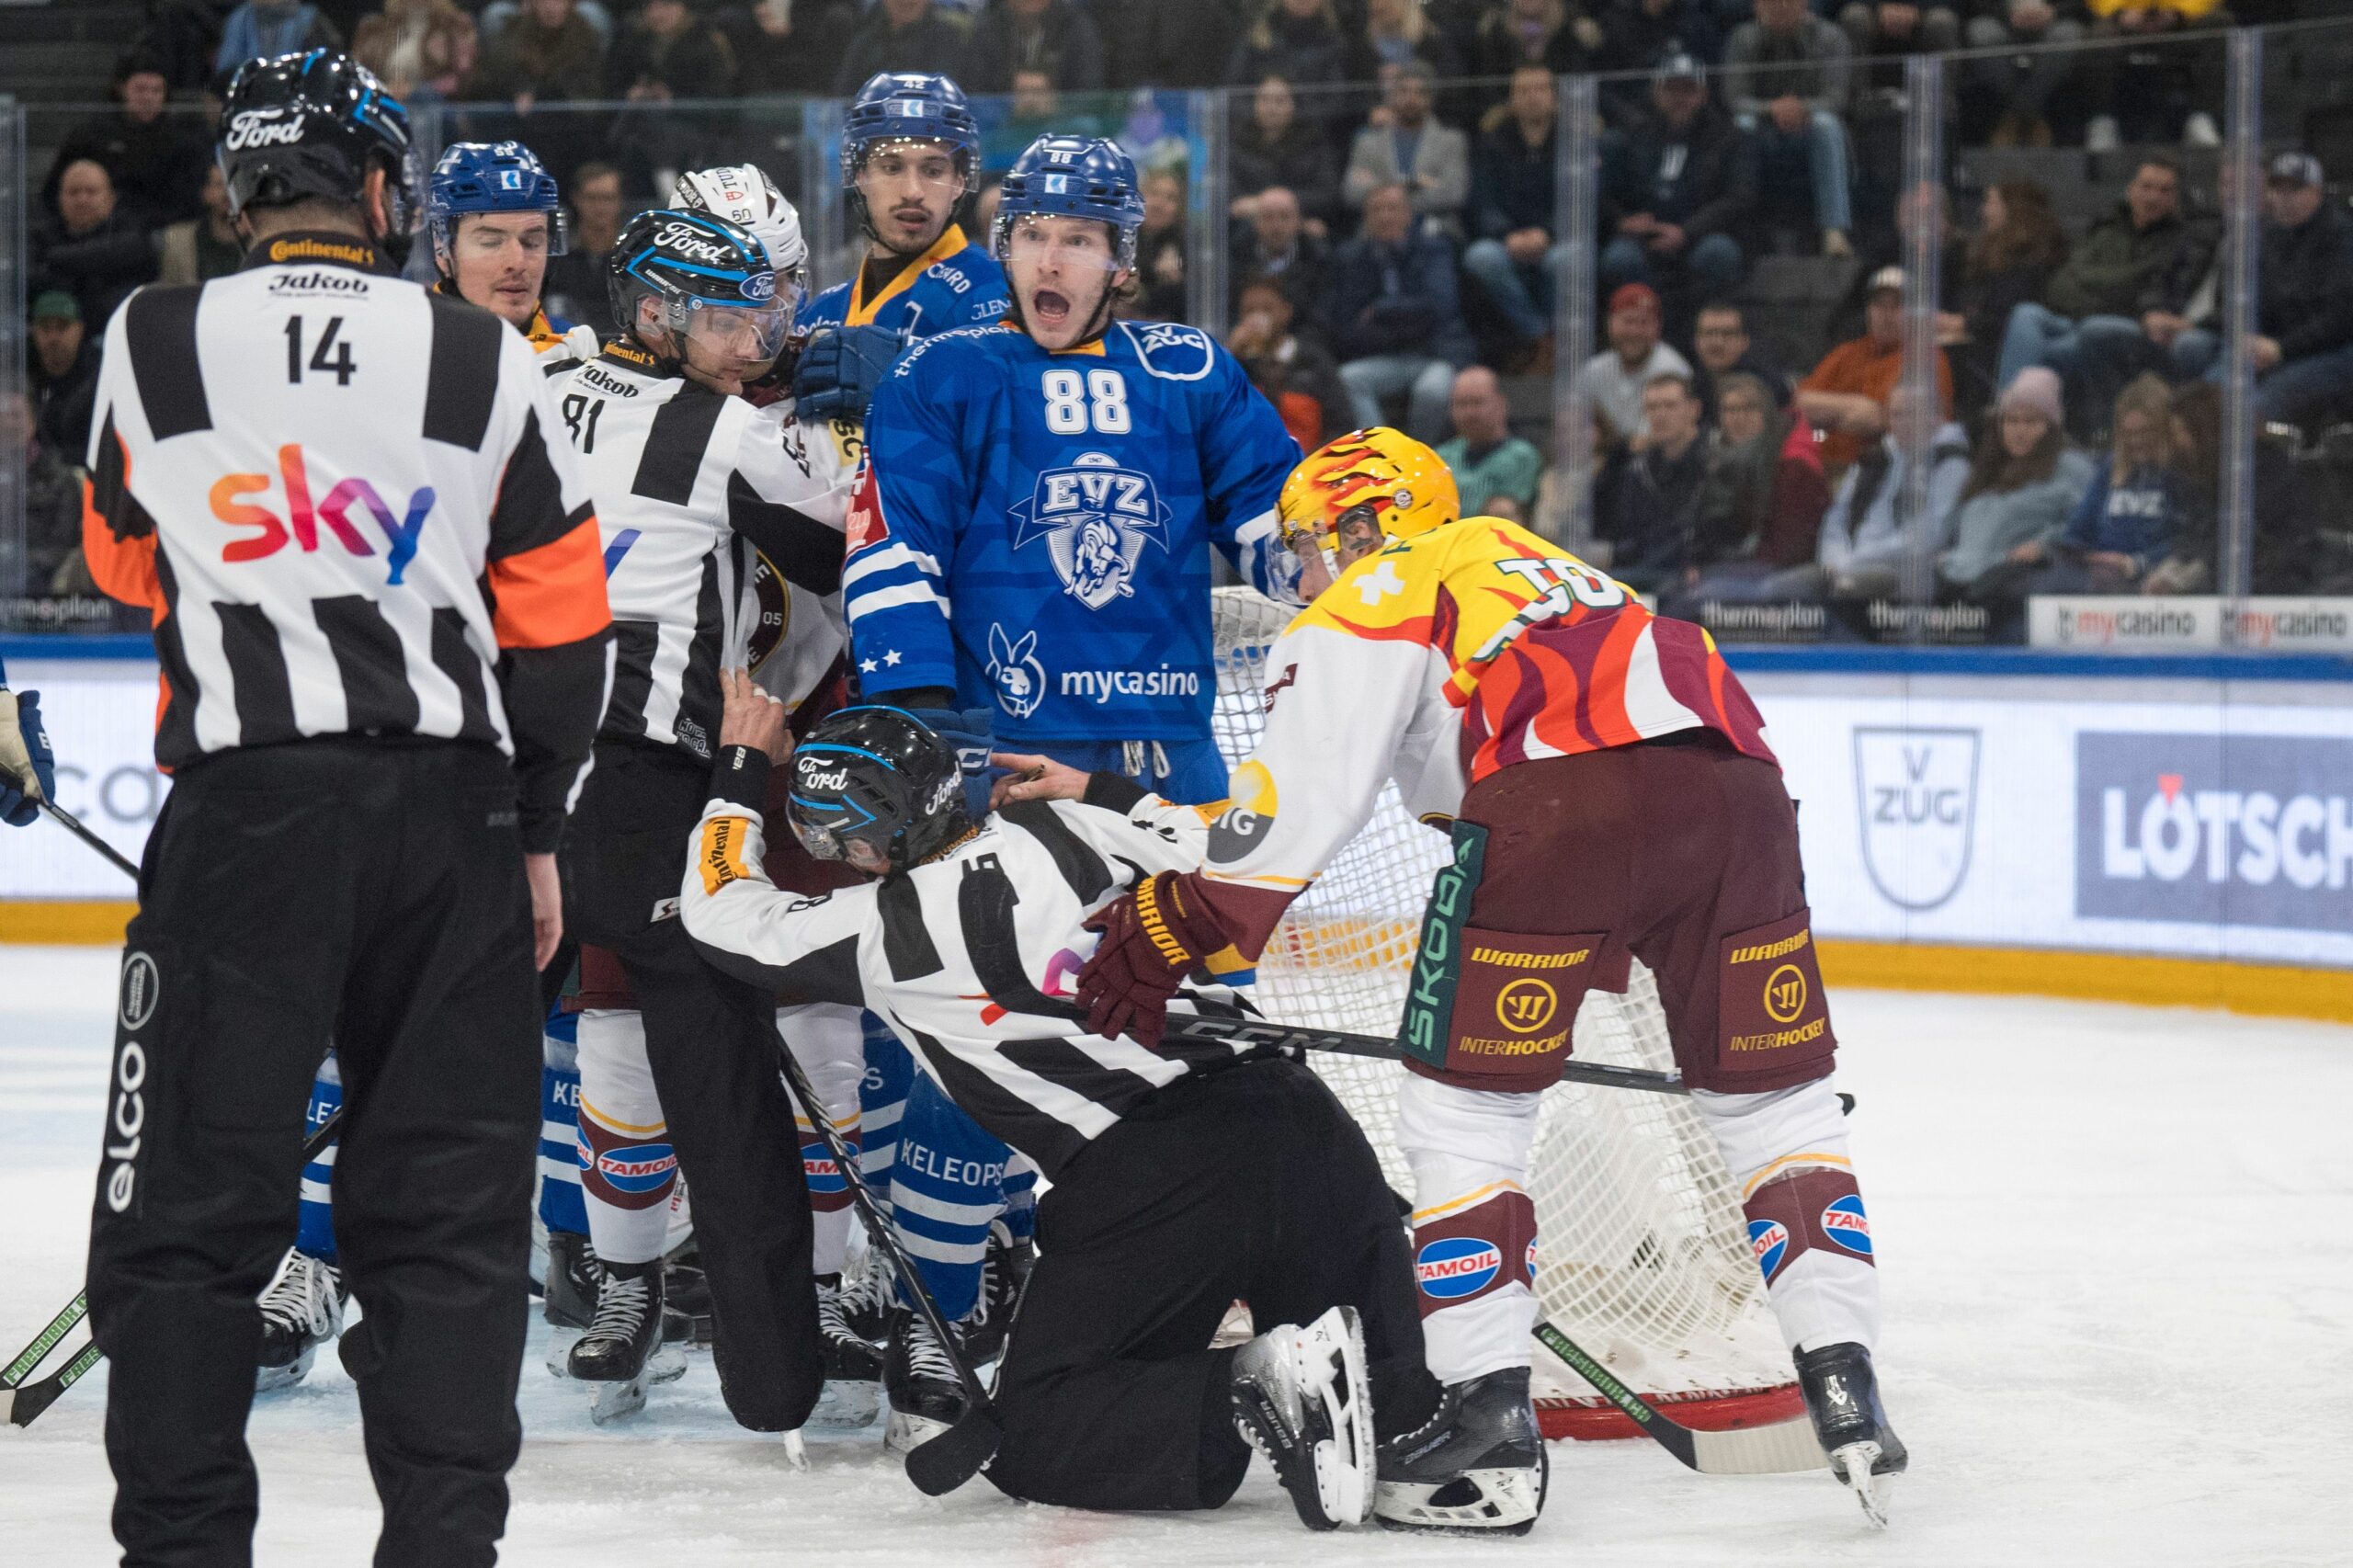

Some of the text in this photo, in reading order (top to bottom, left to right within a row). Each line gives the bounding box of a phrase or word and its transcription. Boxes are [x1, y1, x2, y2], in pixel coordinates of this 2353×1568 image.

[227, 108, 305, 151] Ford
[1050, 152, 1073, 164] 88
[269, 239, 366, 264] Continental
[654, 222, 732, 265] Ford
[268, 273, 369, 295] Jakob
[284, 315, 358, 386] 14
[1141, 334, 1206, 355] ZUG
[1041, 369, 1132, 435] 88
[1041, 471, 1149, 517] EVZ
[208, 443, 437, 586] sky
[762, 610, 783, 627] 05
[2076, 603, 2197, 647] mycasino
[2237, 603, 2347, 647] mycasino
[1060, 663, 1200, 704] mycasino
[798, 756, 848, 790] Ford
[1872, 785, 1964, 825] ZUG
[1470, 947, 1590, 969] WARRIOR
[1730, 928, 1810, 964] WARRIOR
[1459, 1027, 1571, 1056] INTERHOCKEY
[1729, 1017, 1825, 1051] INTERHOCKEY
[108, 1040, 146, 1213] elco
[599, 1153, 678, 1176] TAMOIL
[900, 1137, 1005, 1187] KELEOPS
[1754, 1228, 1786, 1257] OIL
[1417, 1251, 1500, 1280] TAMOIL
[1259, 1400, 1293, 1449] BAUER
